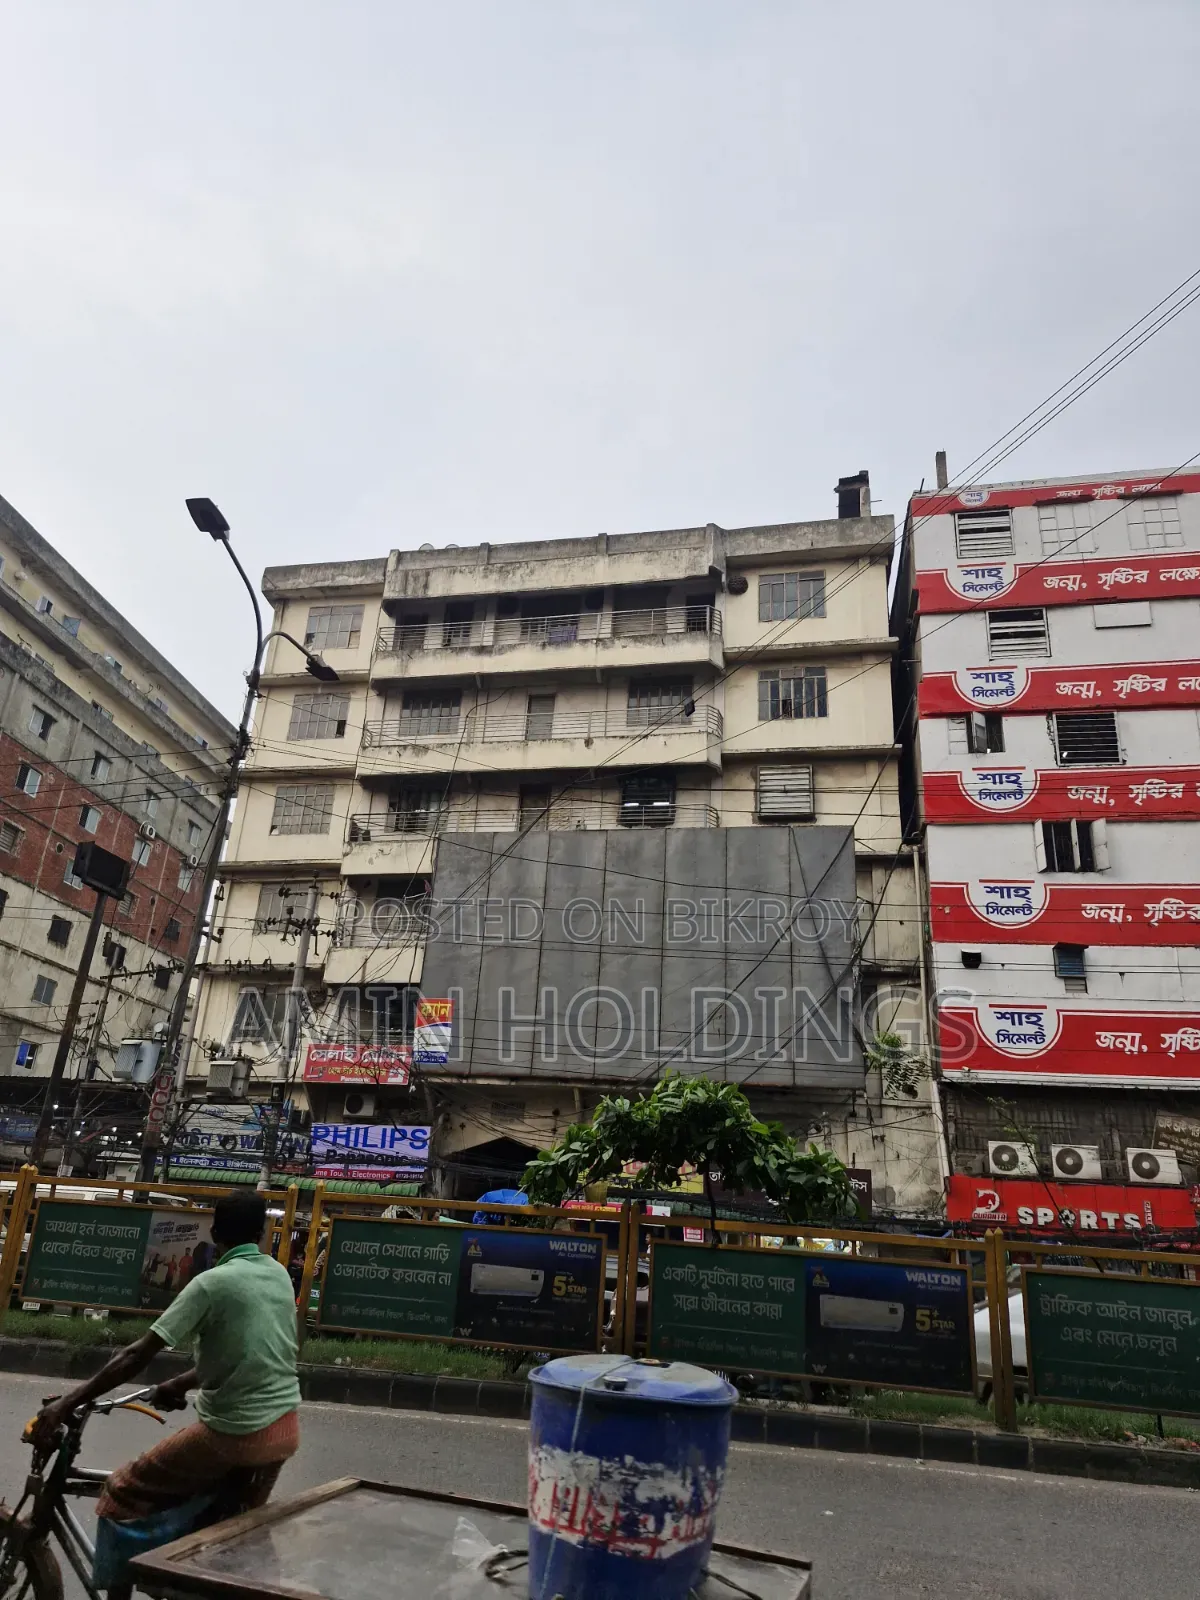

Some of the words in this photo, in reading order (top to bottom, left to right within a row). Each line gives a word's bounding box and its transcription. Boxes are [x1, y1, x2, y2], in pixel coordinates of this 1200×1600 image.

[962, 581, 1004, 593] সিমেন্ট
[1098, 567, 1149, 590] সৃষ্টির
[972, 686, 1015, 698] সিমেন্ট
[1056, 681, 1102, 699] জন্ম,
[1113, 673, 1168, 699] সৃষ্টির
[978, 788, 1024, 801] সিমেন্ট
[1067, 785, 1115, 806] জন্ম,
[1129, 778, 1185, 806] সৃষ্টির
[985, 902, 1033, 917] সিমেন্ট
[1081, 903, 1132, 923] জন্ম,
[995, 1029, 1046, 1045] সিমেন্ট
[1096, 1031, 1148, 1055] জন্ম,
[309, 1046, 357, 1064] সেলাই
[312, 1125, 429, 1150] PHILIPS
[352, 1170, 391, 1179] Electronics
[1017, 1206, 1142, 1230] SPORTS
[45, 1220, 79, 1233] অযথা
[79, 1219, 96, 1236] হর্ন
[98, 1223, 141, 1240] বাজানো
[41, 1241, 71, 1255] থেকে
[71, 1240, 100, 1258] বিরত
[102, 1246, 136, 1265] থাকুন
[340, 1240, 381, 1256] যেখানে
[382, 1243, 421, 1259] সেখানে
[423, 1243, 451, 1264] গাড়ি
[549, 1240, 597, 1254] WALTON
[567, 1252, 596, 1260] Conditioner
[333, 1262, 391, 1280] ওভারটেক
[391, 1268, 437, 1285] করবেন
[438, 1272, 452, 1286] না
[662, 1264, 698, 1283] একটি
[698, 1265, 739, 1289] দুর্ঘটনা
[741, 1273, 765, 1289] হতে
[767, 1276, 796, 1293] পারে
[905, 1270, 961, 1286] WALTON
[567, 1285, 587, 1295] STAR
[673, 1294, 699, 1312] সারা
[700, 1292, 751, 1316] জীবনের
[752, 1301, 783, 1320] কান্না
[1040, 1293, 1093, 1317] ট্রাফিক
[1095, 1300, 1142, 1321] আইন
[932, 1319, 955, 1330] STAR
[1060, 1326, 1093, 1343] এবং
[1096, 1330, 1134, 1349] মেনে
[1137, 1334, 1177, 1357] চলুন
